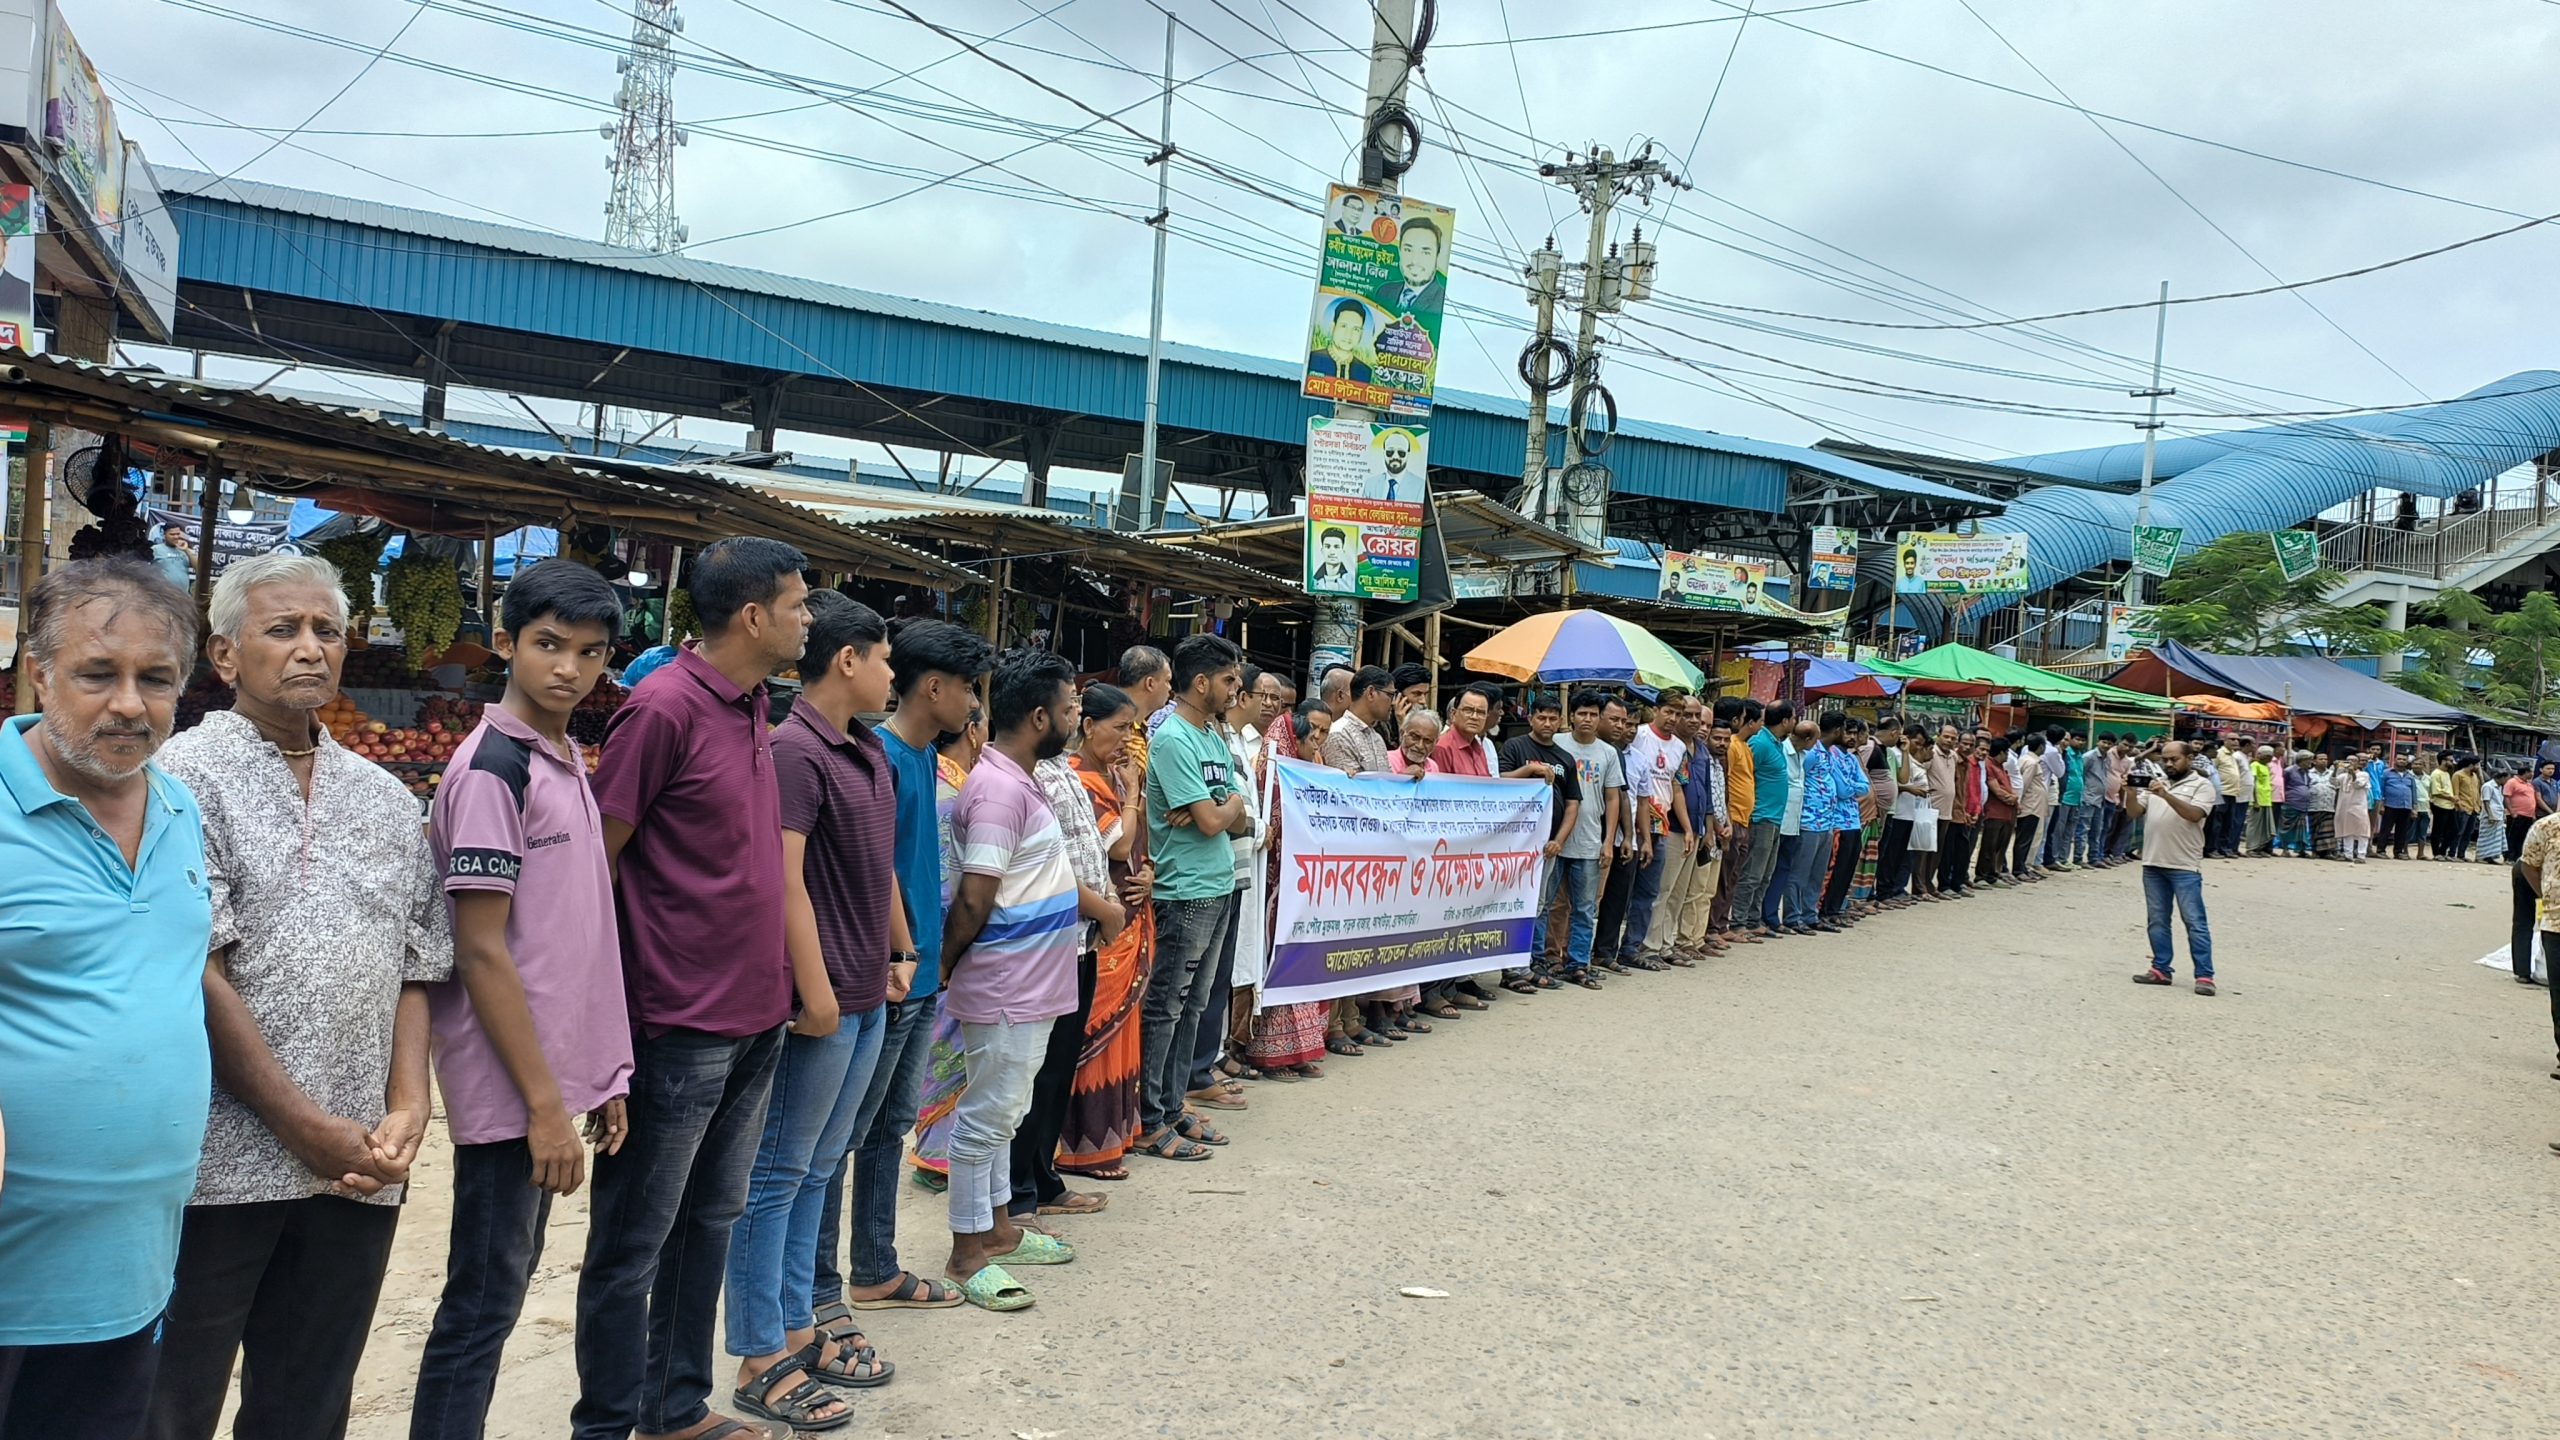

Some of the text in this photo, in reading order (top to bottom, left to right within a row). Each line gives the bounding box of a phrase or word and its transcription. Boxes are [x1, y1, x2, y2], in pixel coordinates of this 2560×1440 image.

[1325, 256, 1389, 280] সালাম নিন
[1374, 365, 1427, 391] শুভেচ্ছা
[1334, 380, 1363, 399] লিটন
[1365, 385, 1390, 405] মিয়া
[246, 531, 277, 545] হোসেন
[1367, 536, 1417, 556] মেয়র
[1308, 810, 1337, 832] আইনগত
[1338, 816, 1357, 835] ব্যবস্থা
[527, 831, 571, 850] Generation
[1293, 847, 1407, 907] মানববন্ধন
[1411, 857, 1426, 896] ও
[1428, 838, 1485, 899] বিক্ষোভ
[1306, 915, 1321, 934] পৌর
[1377, 943, 1409, 965] সচেতন
[1408, 931, 1449, 959] এলাকাবাসী
[1449, 937, 1455, 952] ও
[1456, 929, 1473, 956] হিন্দু
